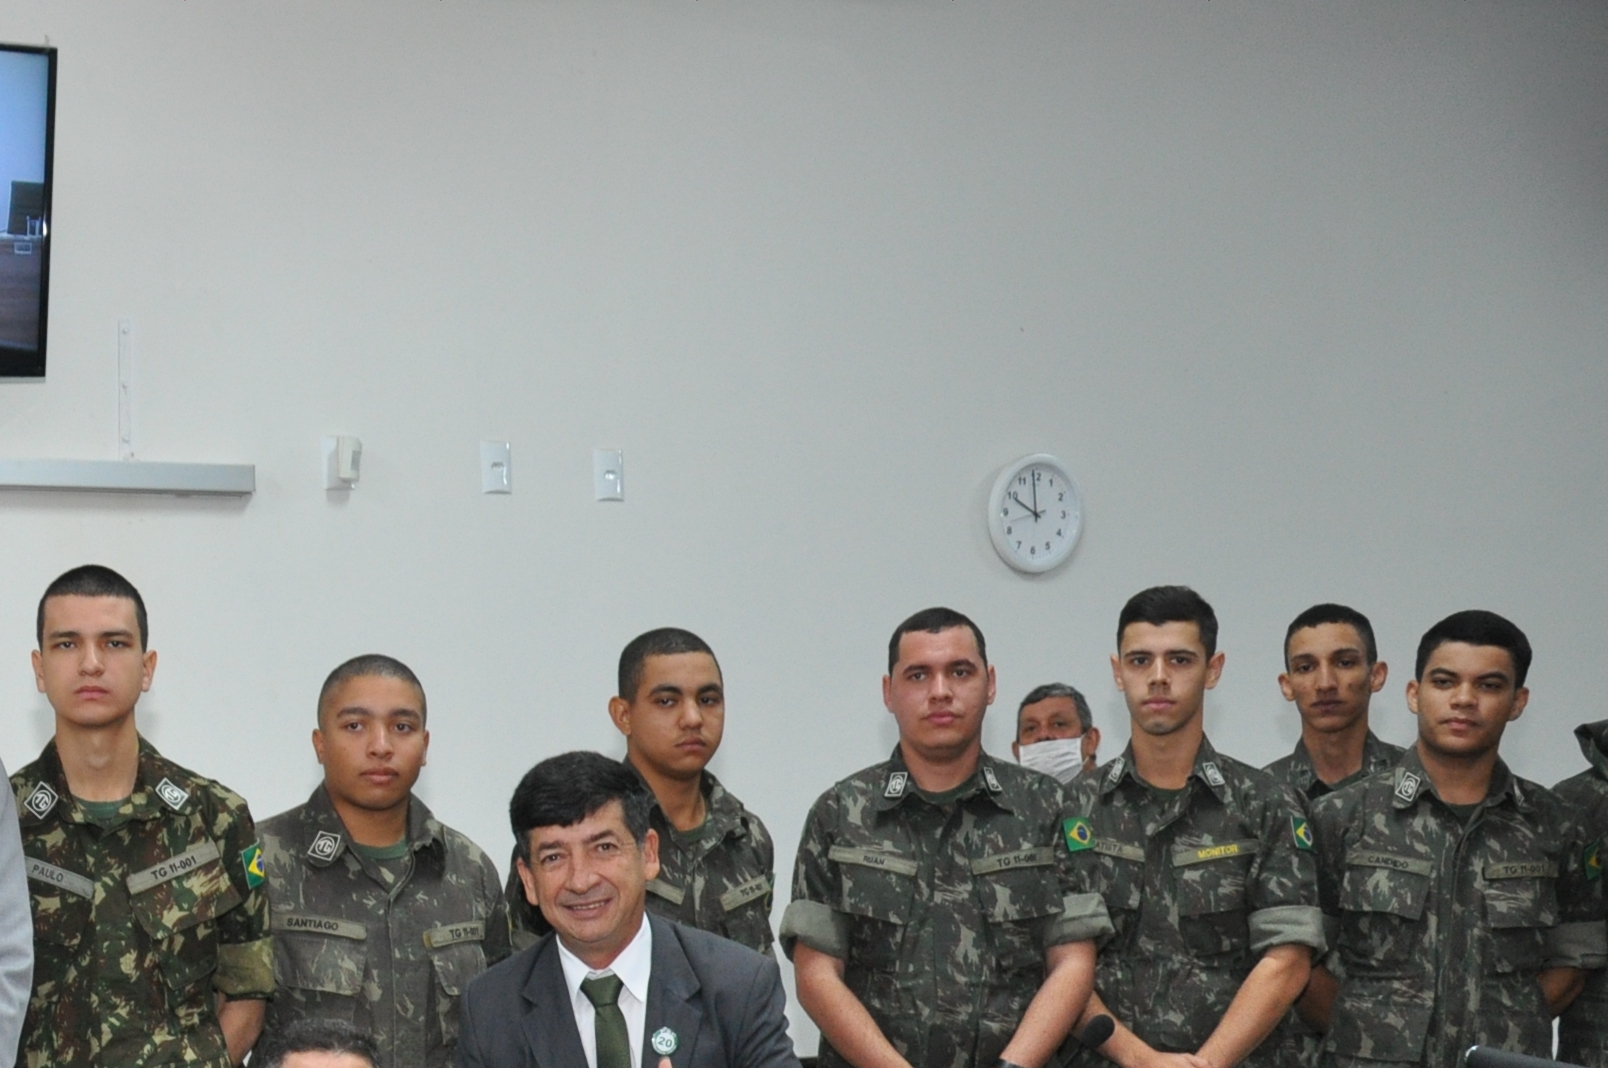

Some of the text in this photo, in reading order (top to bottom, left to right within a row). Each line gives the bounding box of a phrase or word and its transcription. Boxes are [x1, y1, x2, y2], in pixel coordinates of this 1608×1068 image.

[1018, 477, 1027, 485] 11
[1048, 478, 1054, 487] 1
[1007, 491, 1018, 500] 10
[1058, 492, 1064, 501] 2
[1002, 507, 1009, 516] 9
[1061, 510, 1067, 519] 3
[1006, 526, 1013, 535] 8
[1056, 528, 1062, 537] 4
[1016, 541, 1022, 549] 7
[1045, 541, 1051, 550] 5
[1030, 546, 1036, 555] 6
[317, 839, 334, 854] TG
[1095, 839, 1123, 856] ATISTA
[1197, 844, 1239, 860] MONITOR
[996, 857, 1011, 868] TG
[150, 854, 198, 881] TG 11-001
[1503, 865, 1518, 875] TG
[31, 864, 64, 883] PAULO
[286, 917, 339, 931] SANTIAGO
[449, 928, 462, 939] TG
[657, 1036, 673, 1048] 20
